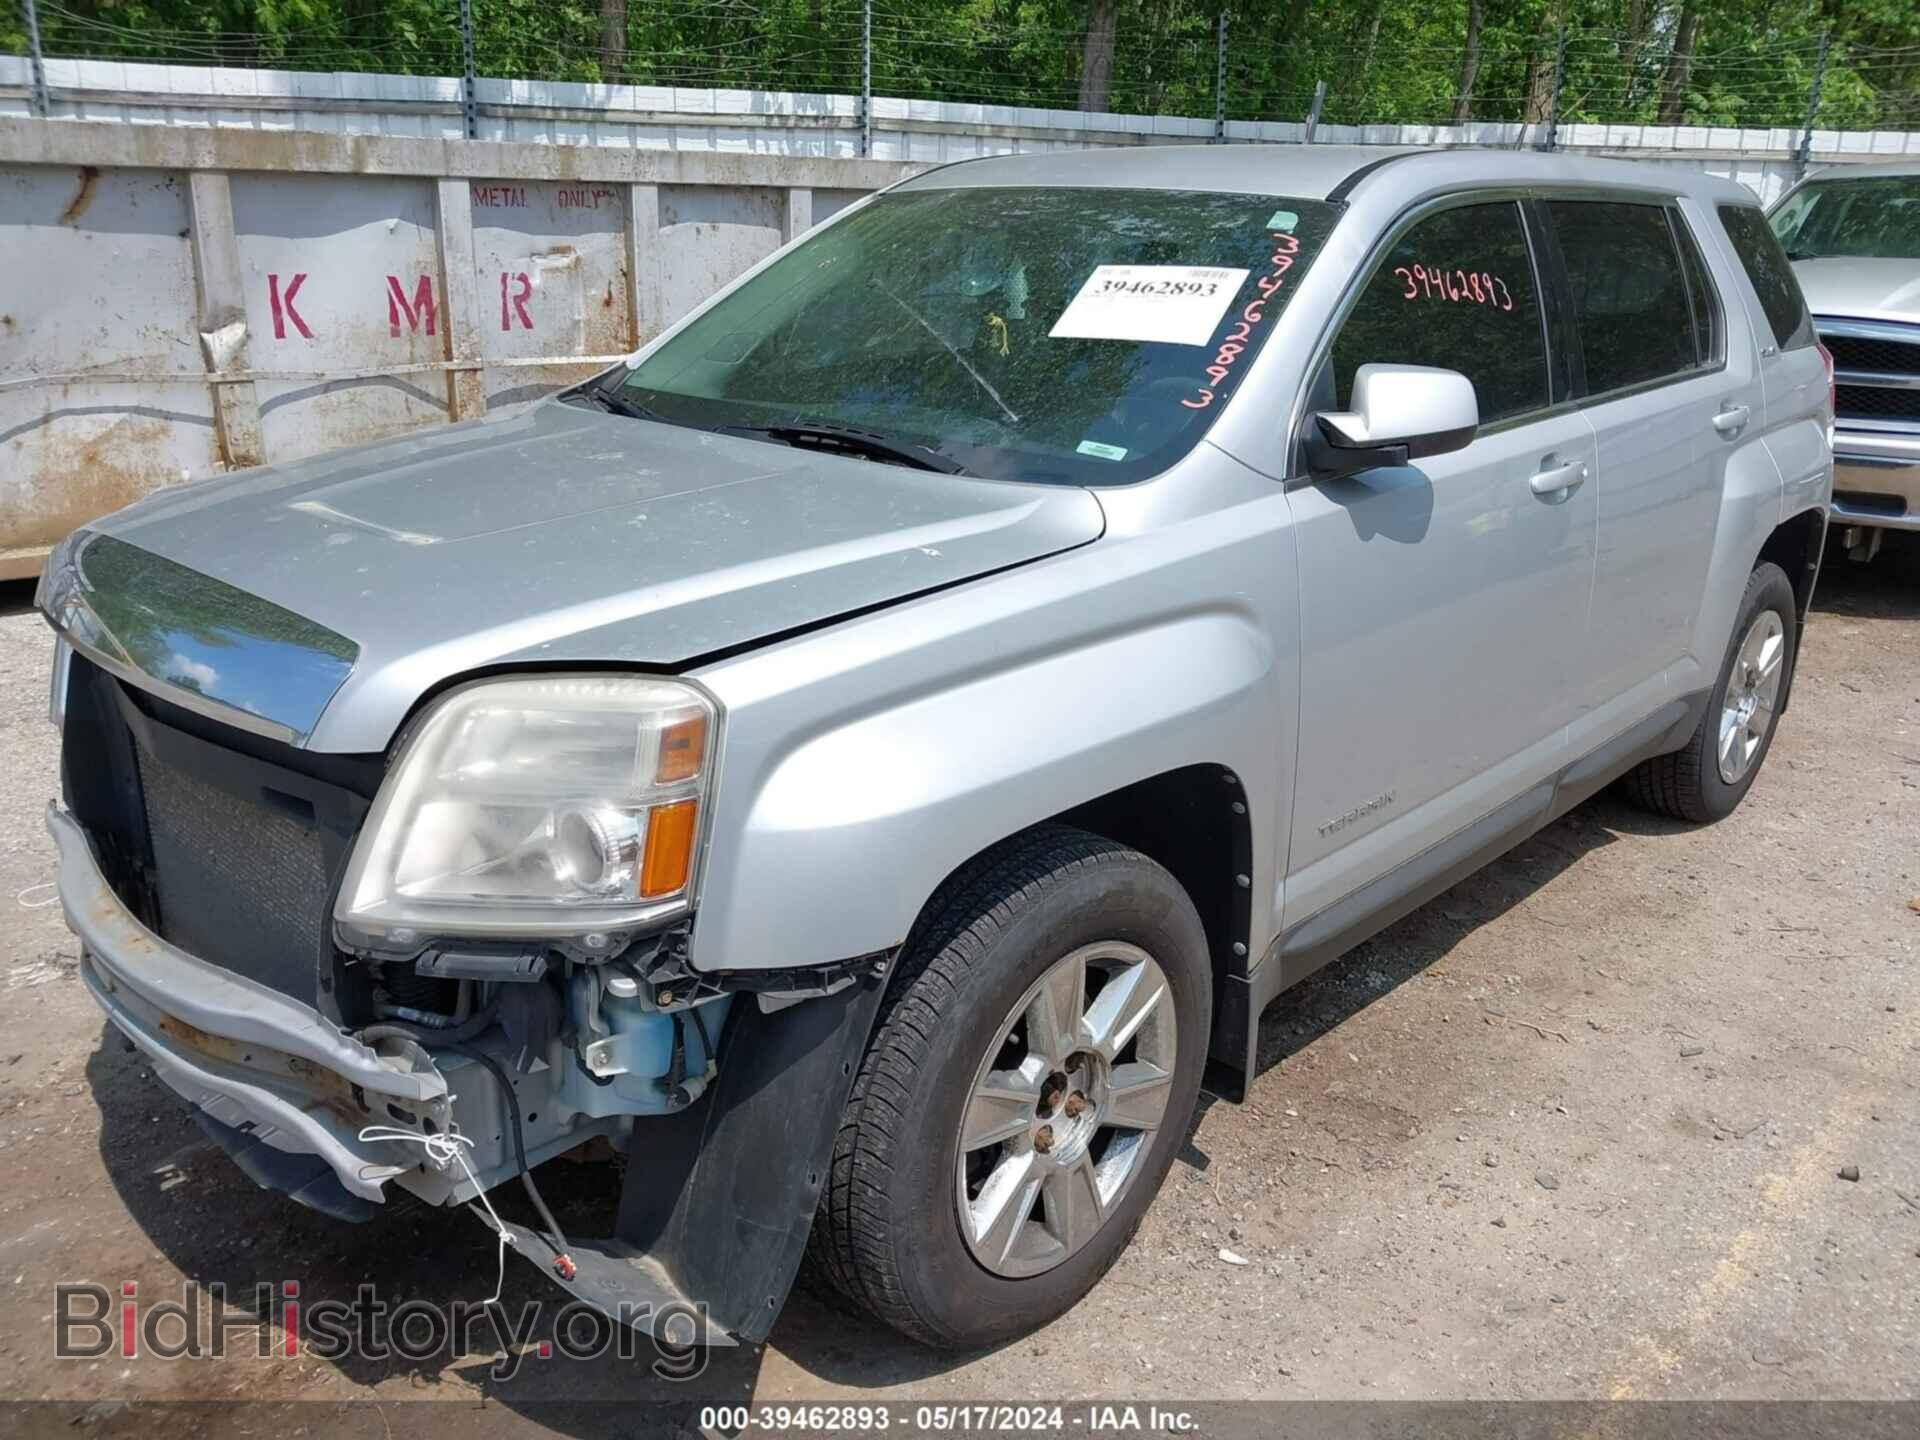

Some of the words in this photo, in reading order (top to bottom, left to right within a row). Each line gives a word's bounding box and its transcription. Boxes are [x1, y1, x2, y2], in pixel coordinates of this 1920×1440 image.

[473, 186, 527, 209] METAL
[557, 189, 603, 209] ONLY
[1094, 280, 1218, 297] 39462893
[1395, 264, 1513, 311] 39462893
